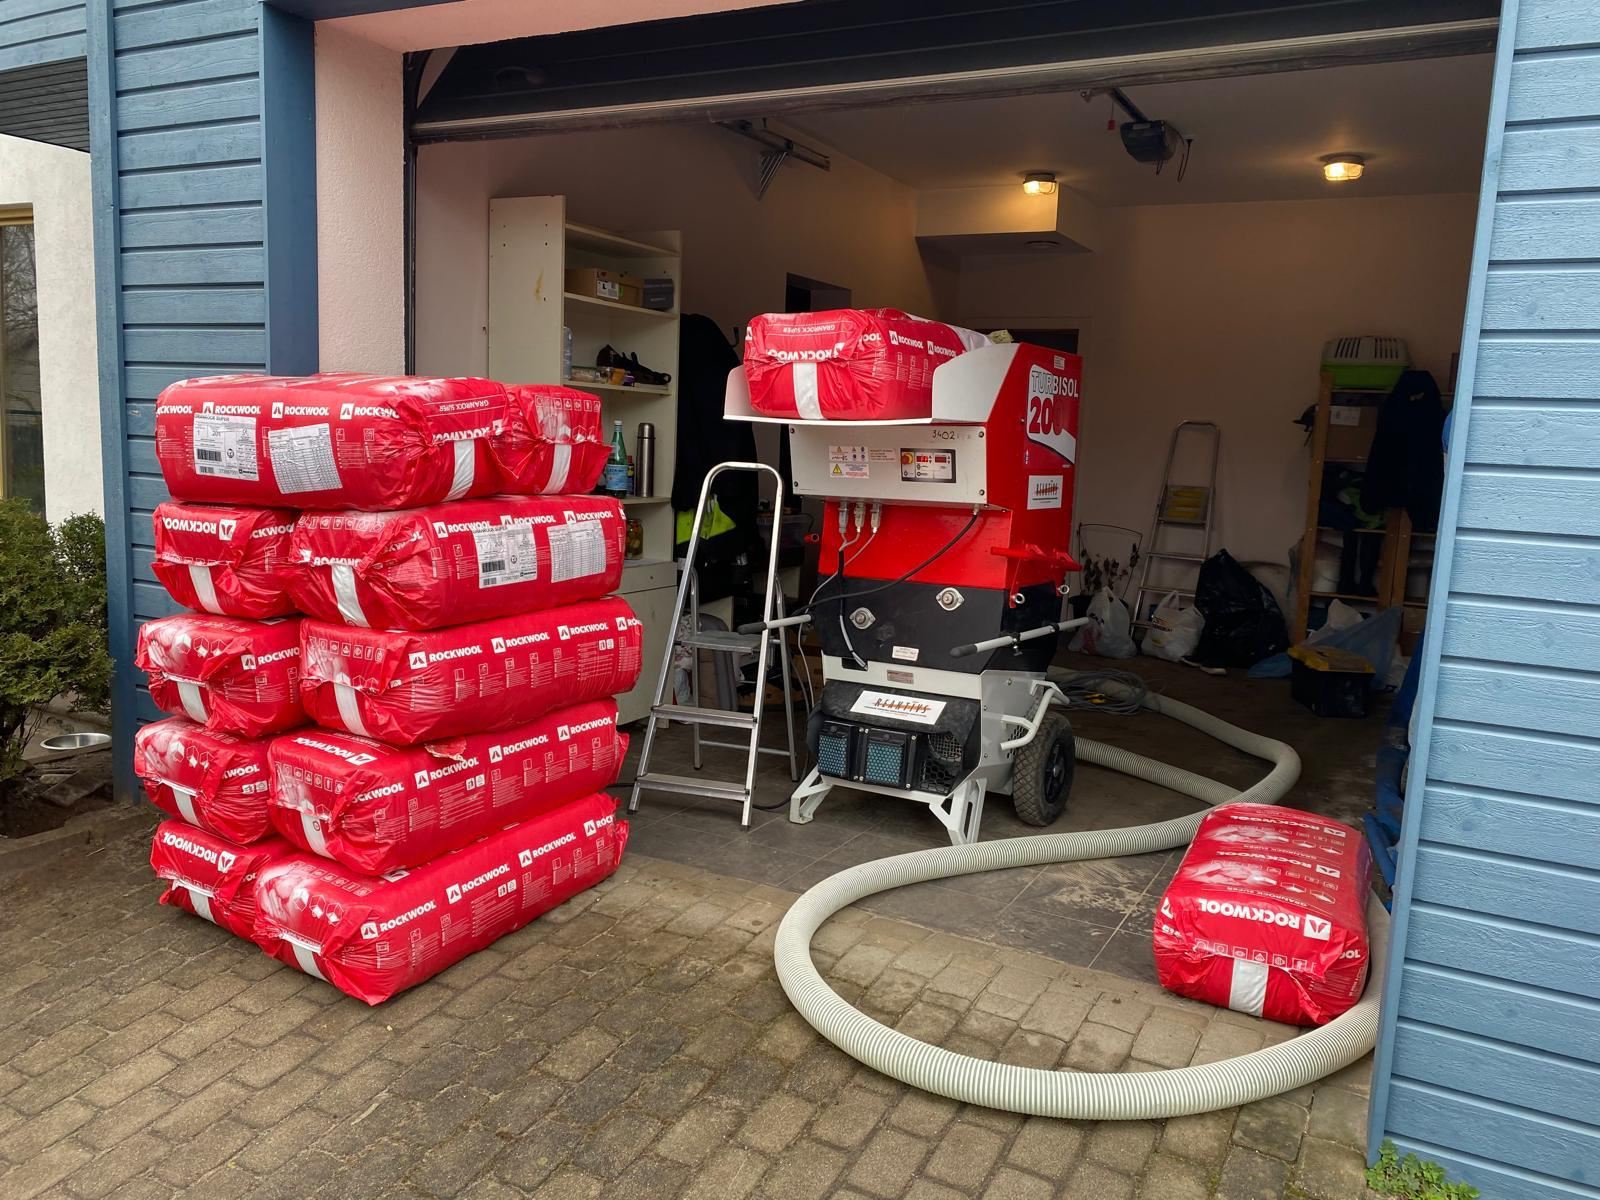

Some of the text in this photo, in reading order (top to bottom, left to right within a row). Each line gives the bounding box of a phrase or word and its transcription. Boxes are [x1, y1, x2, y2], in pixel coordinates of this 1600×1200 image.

[767, 349, 832, 361] ROCKWOO
[1032, 370, 1079, 398] TURBISOL
[215, 405, 261, 414] ROCKWOOL
[284, 405, 330, 416] ROCKWOOL
[932, 429, 955, 440] 3402
[514, 515, 556, 527] ROCKWOOL
[576, 510, 614, 521] ROCKWOOL
[162, 517, 217, 535] ROCKWOO
[448, 520, 491, 533] ROCKWOOL
[570, 622, 609, 635] ROCKWOOL
[506, 631, 550, 647] ROCKWOOL
[258, 647, 299, 665] ROCKWO
[429, 645, 483, 663] ROCKWOOL
[570, 716, 613, 735] ROCKWOOL
[503, 734, 549, 756] ROCKWOOL
[430, 756, 479, 781] ROCKWOOL
[1230, 815, 1320, 830] ROCKWOOL
[163, 832, 218, 865] ROCKWOOL
[533, 832, 577, 858] ROCKWOOL
[1216, 851, 1312, 868] ROCKWOOL
[462, 863, 511, 893] ROCKWOOL
[380, 899, 437, 931] ROCKWOOL
[1198, 898, 1301, 930] ROCKWOOL
